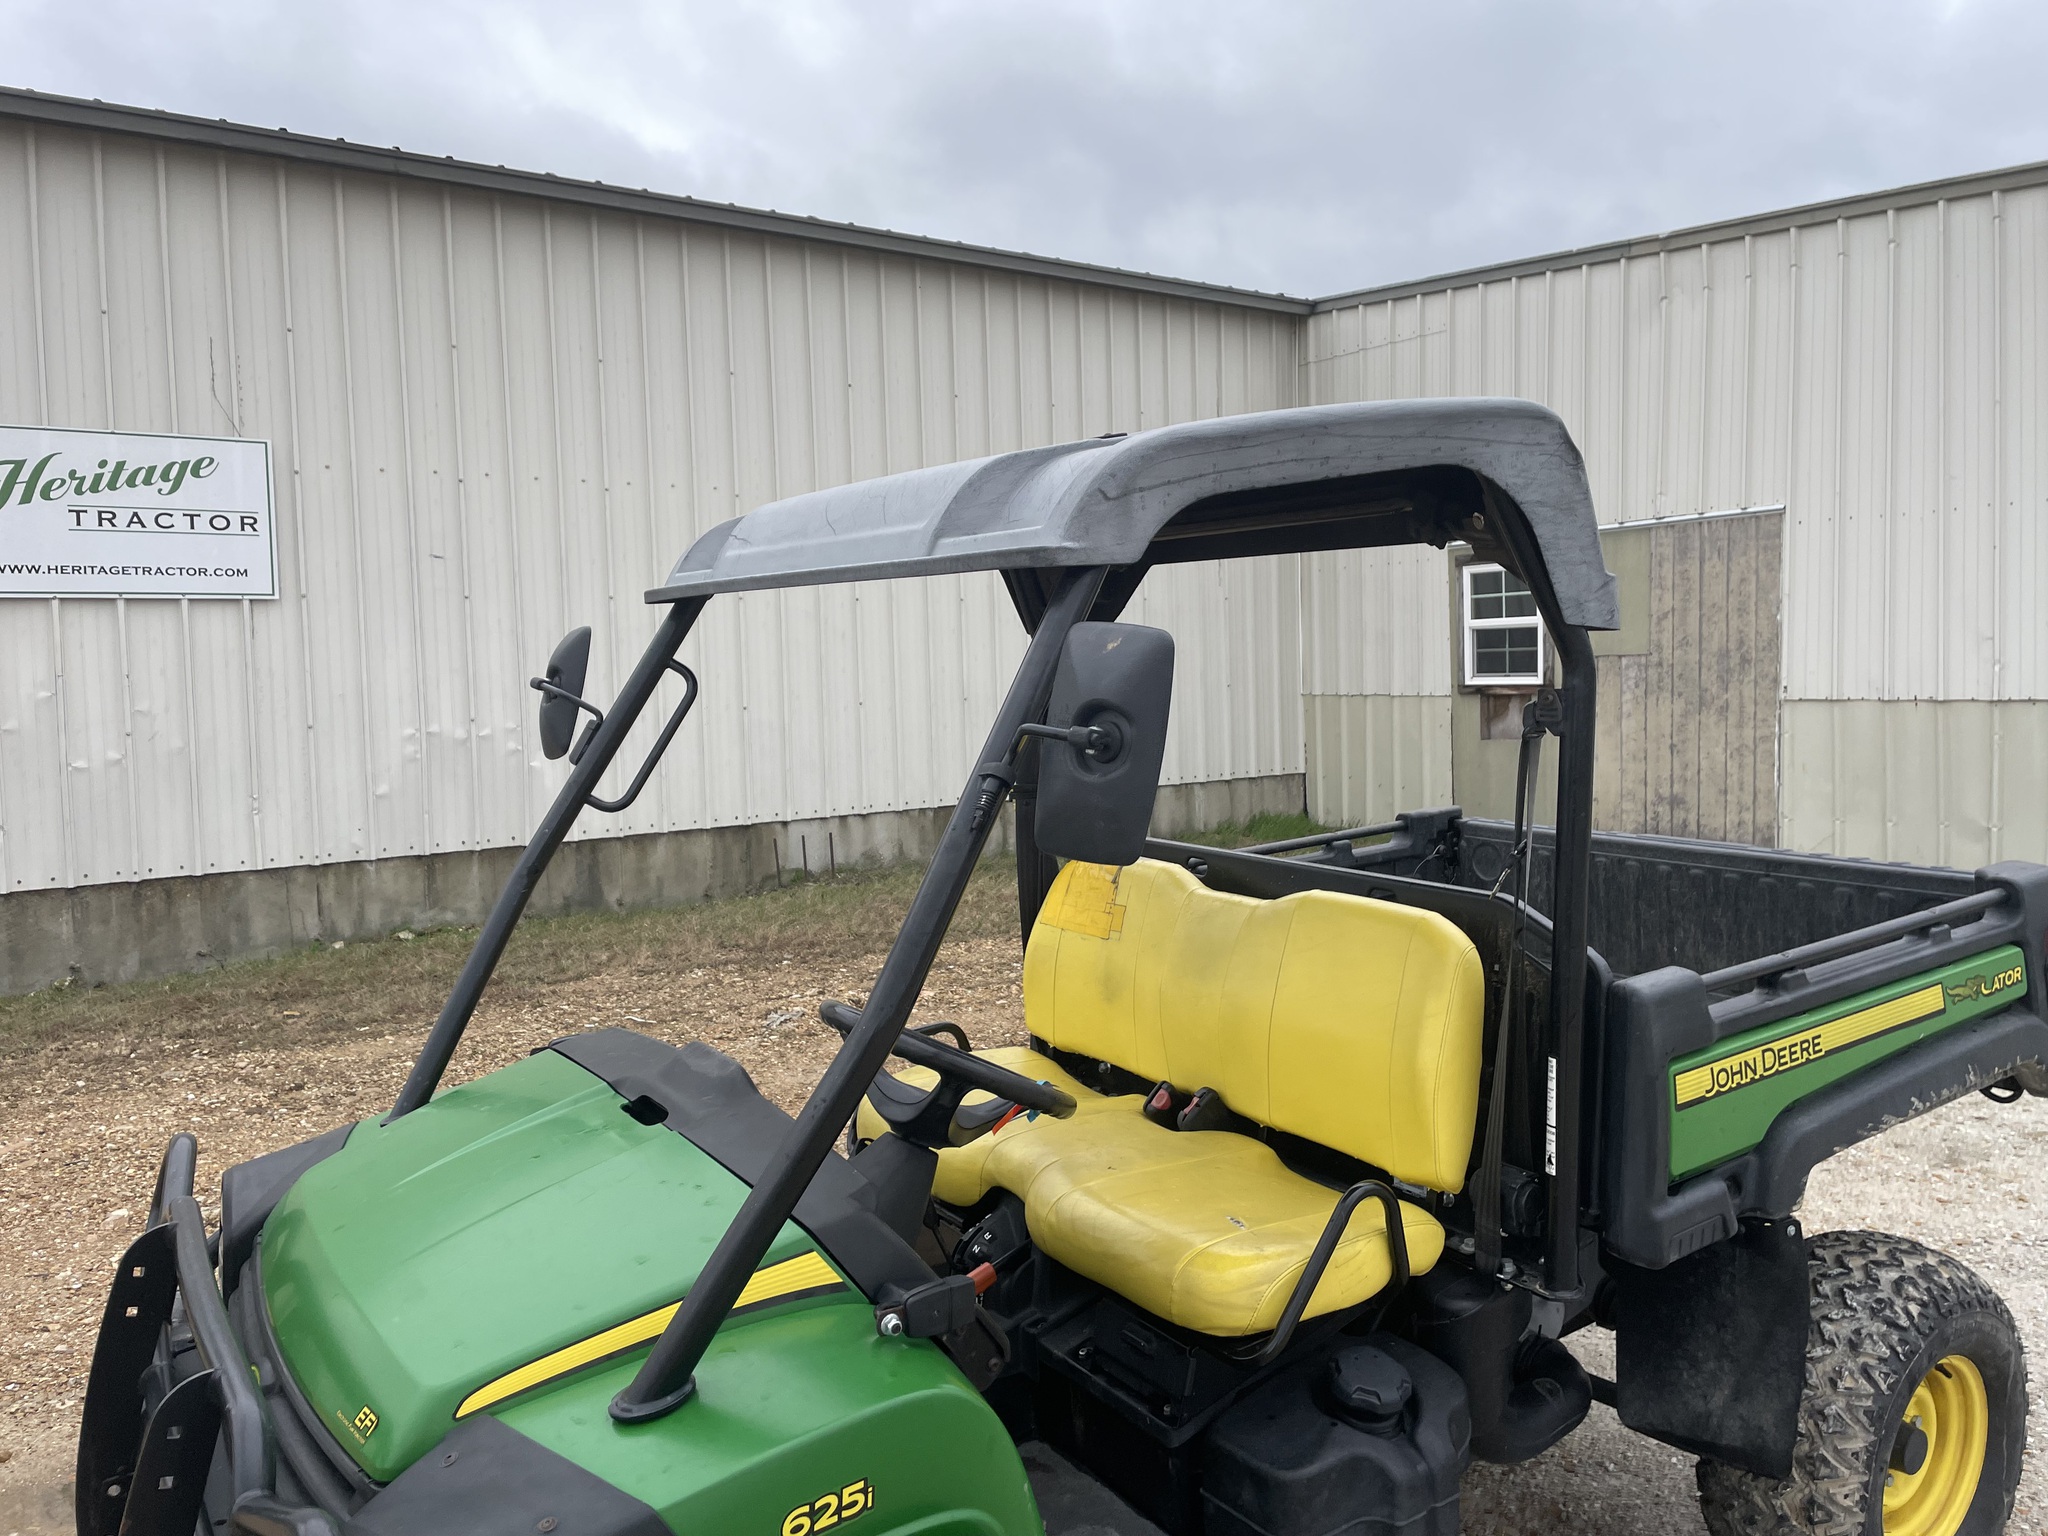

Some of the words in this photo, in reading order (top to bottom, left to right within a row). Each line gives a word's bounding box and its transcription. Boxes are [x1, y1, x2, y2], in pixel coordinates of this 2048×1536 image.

[0, 452, 220, 510] Heritage
[68, 508, 259, 532] TRACTOR
[1704, 1056, 1758, 1095] JOHN
[1761, 1034, 1823, 1074] DEERE
[353, 1405, 379, 1437] EFI
[781, 1479, 873, 1536] 625i
